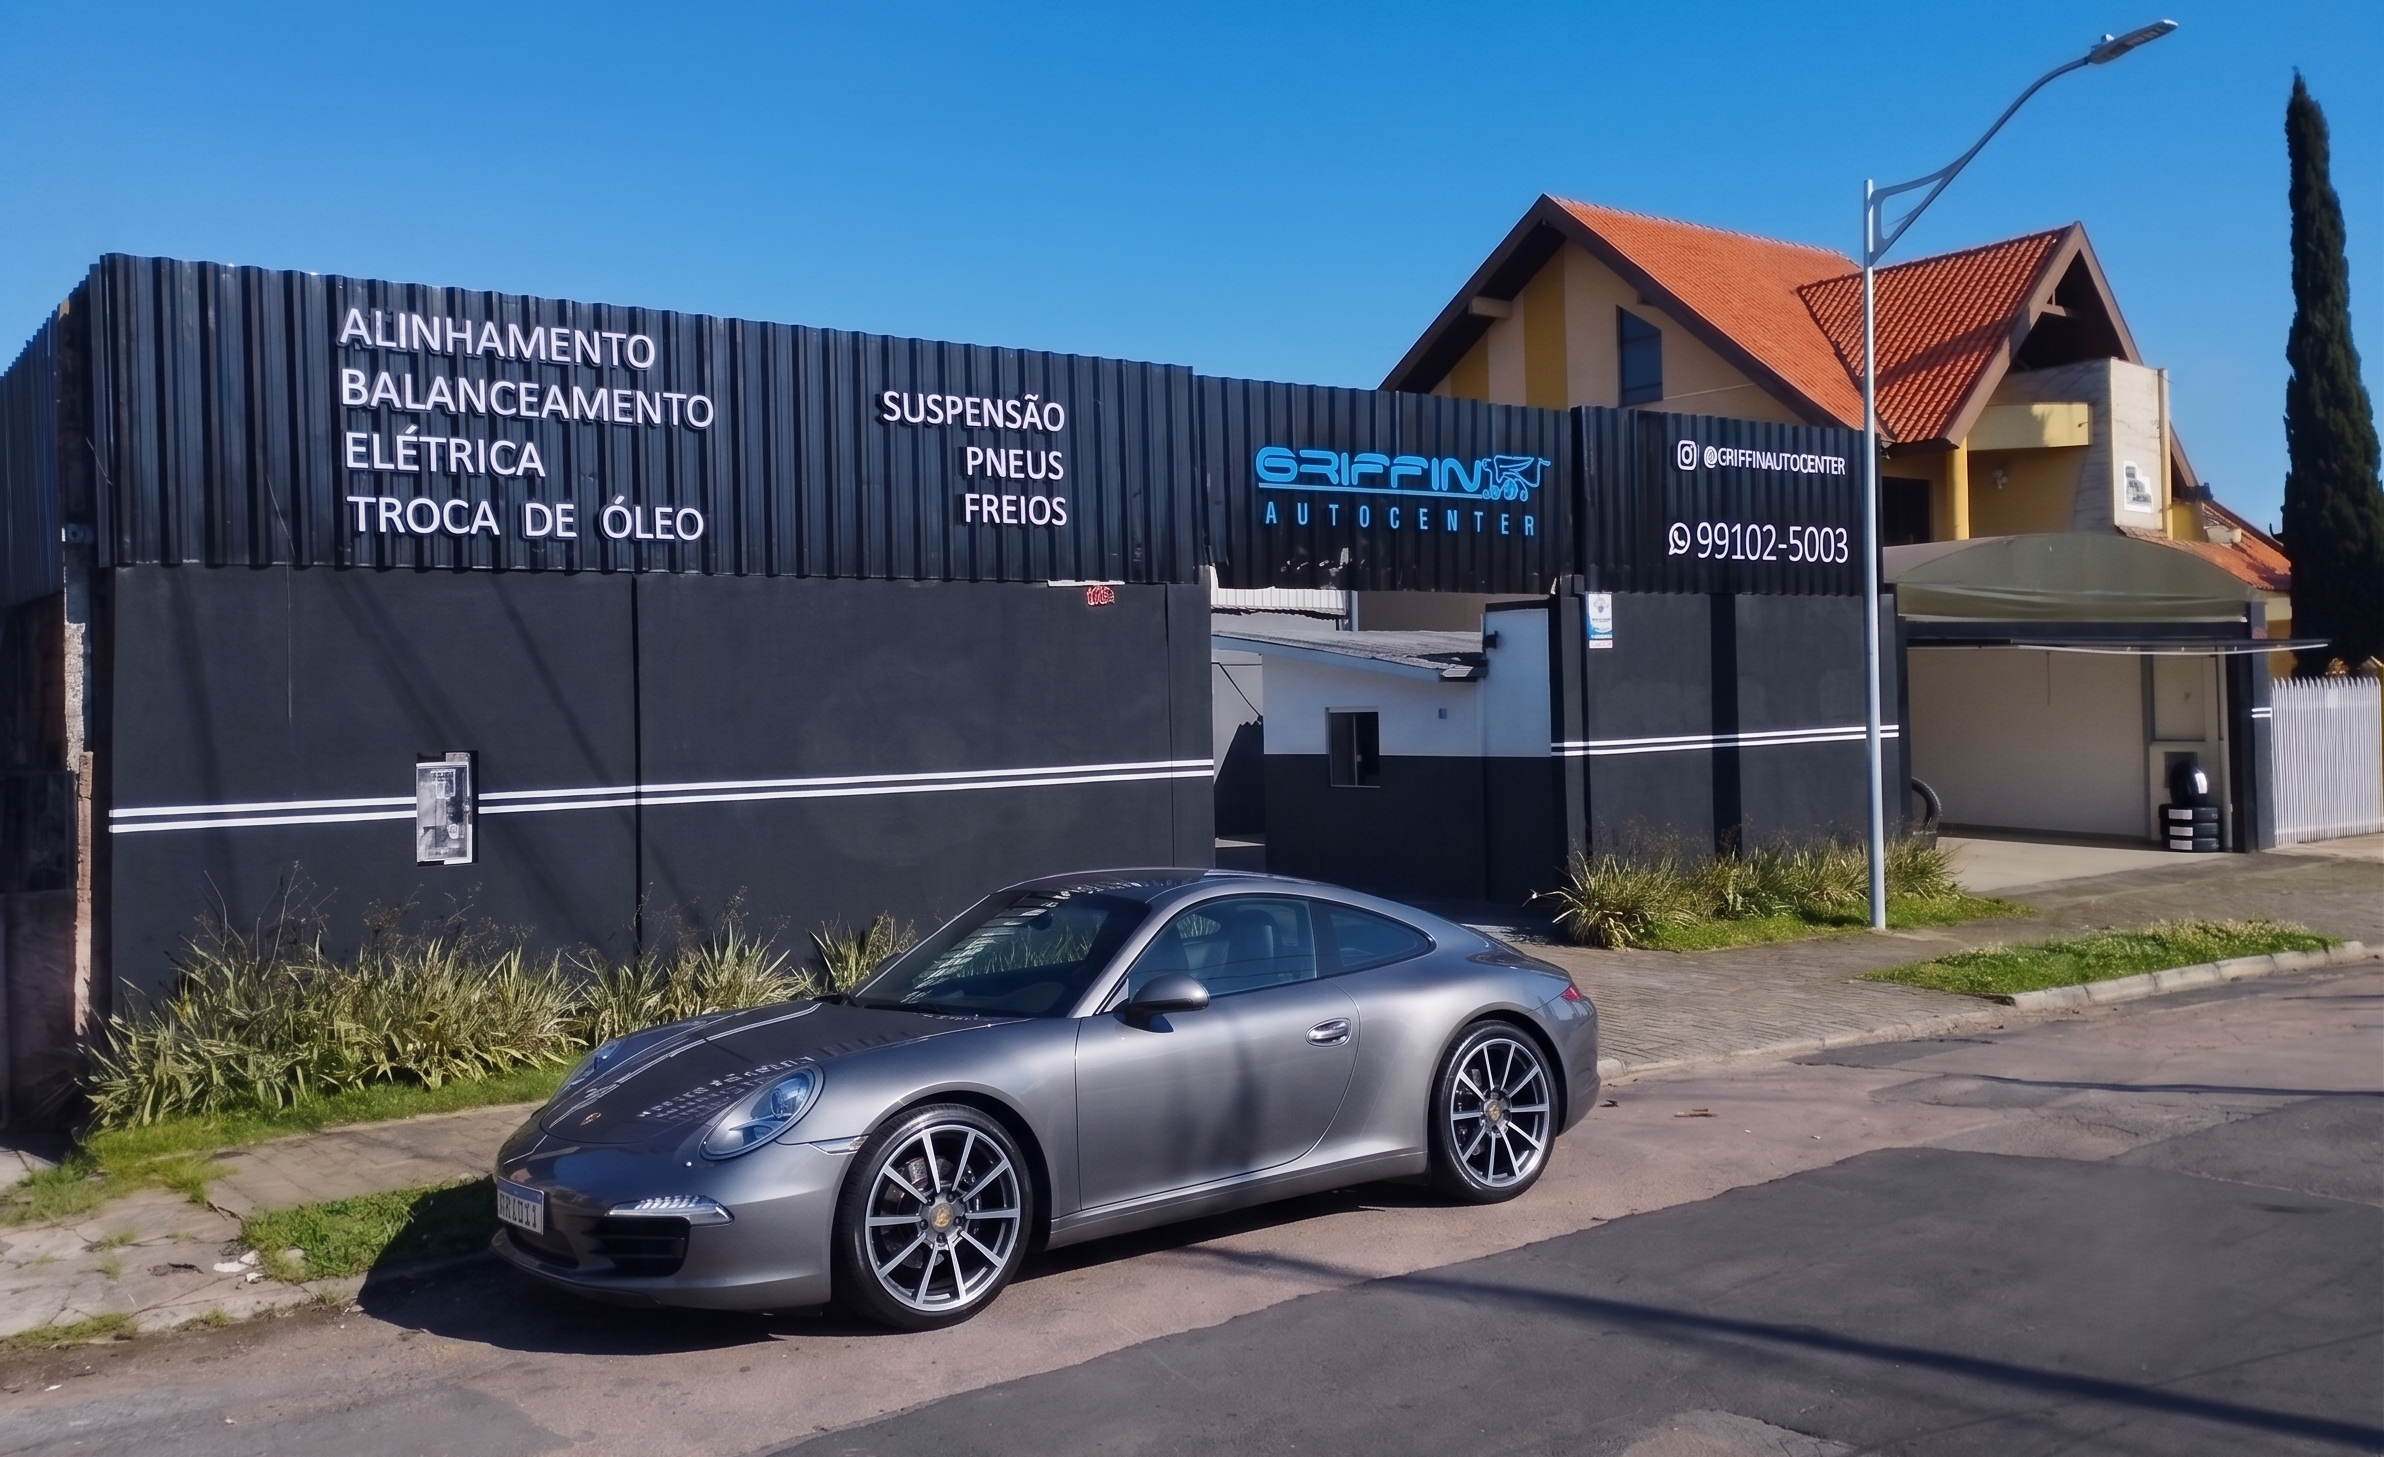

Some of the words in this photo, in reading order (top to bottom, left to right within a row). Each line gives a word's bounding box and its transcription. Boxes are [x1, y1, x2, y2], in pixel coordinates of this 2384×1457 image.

[339, 307, 656, 370] ALINHAMENTO
[341, 367, 714, 428] BALANCEAMENTO
[882, 390, 1065, 432] SUSPENSÃO
[345, 424, 547, 478] ELÉTRICA
[966, 446, 1064, 480] PNEUS
[1256, 446, 1482, 493] GRIFFIN
[1703, 445, 1846, 476] @GRIFFINAUTOCENTER
[346, 495, 500, 536] TROCA
[525, 502, 578, 538] DE
[602, 494, 704, 541] ÓLEO
[964, 493, 1068, 526] FREIOS
[1265, 501, 1535, 537] AUTOCENTER
[1696, 521, 1849, 564] 99102-5003
